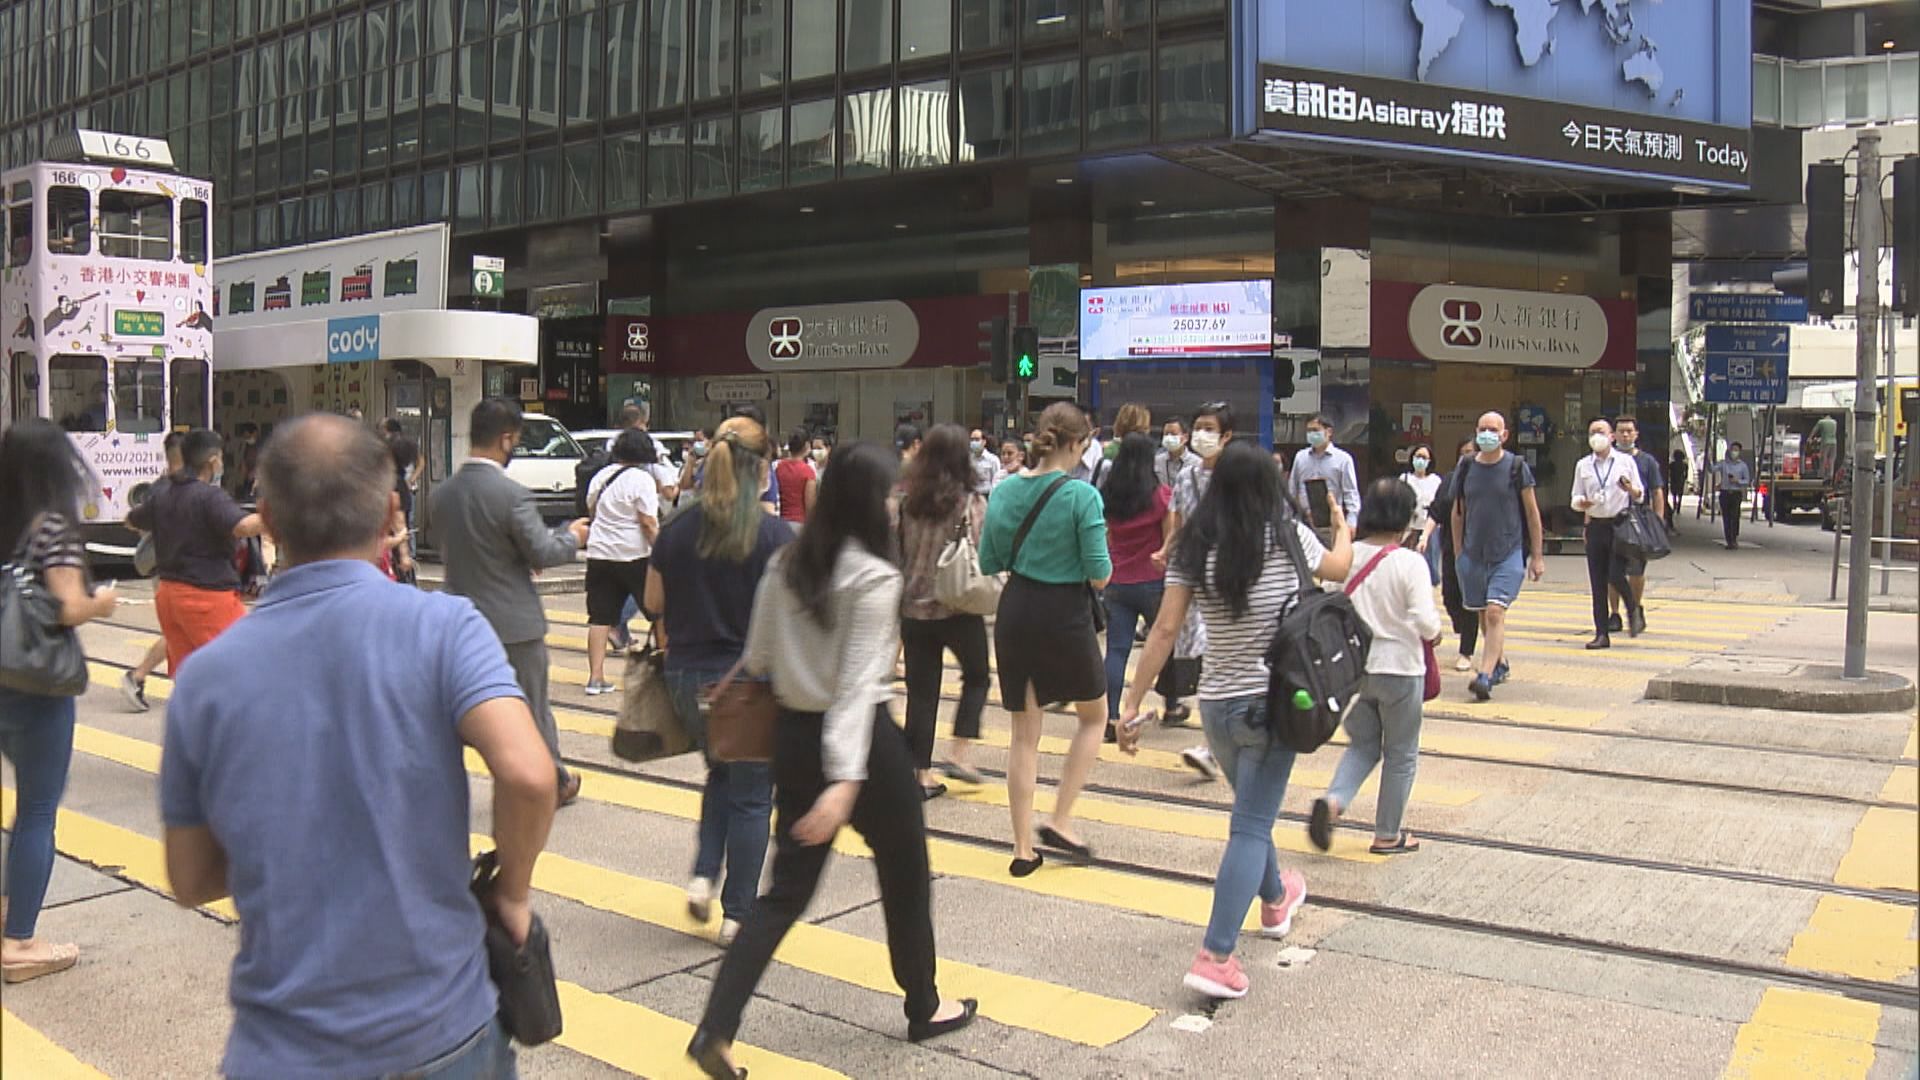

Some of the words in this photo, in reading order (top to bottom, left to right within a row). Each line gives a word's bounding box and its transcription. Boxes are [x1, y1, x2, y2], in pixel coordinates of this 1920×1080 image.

[1264, 78, 1506, 139] 資訊由Asiaray提供
[1562, 120, 1682, 160] 今日天氣預測
[1695, 139, 1748, 173] Today
[102, 135, 150, 160] 166
[52, 171, 76, 184] 166
[193, 187, 209, 199] 166
[81, 267, 190, 288] 香港小交響樂團
[1775, 297, 1803, 306] Station
[806, 314, 889, 338] 大新銀行
[1173, 318, 1226, 332] 25037.69
[1493, 303, 1580, 331] 大新銀行
[329, 324, 378, 354] cody
